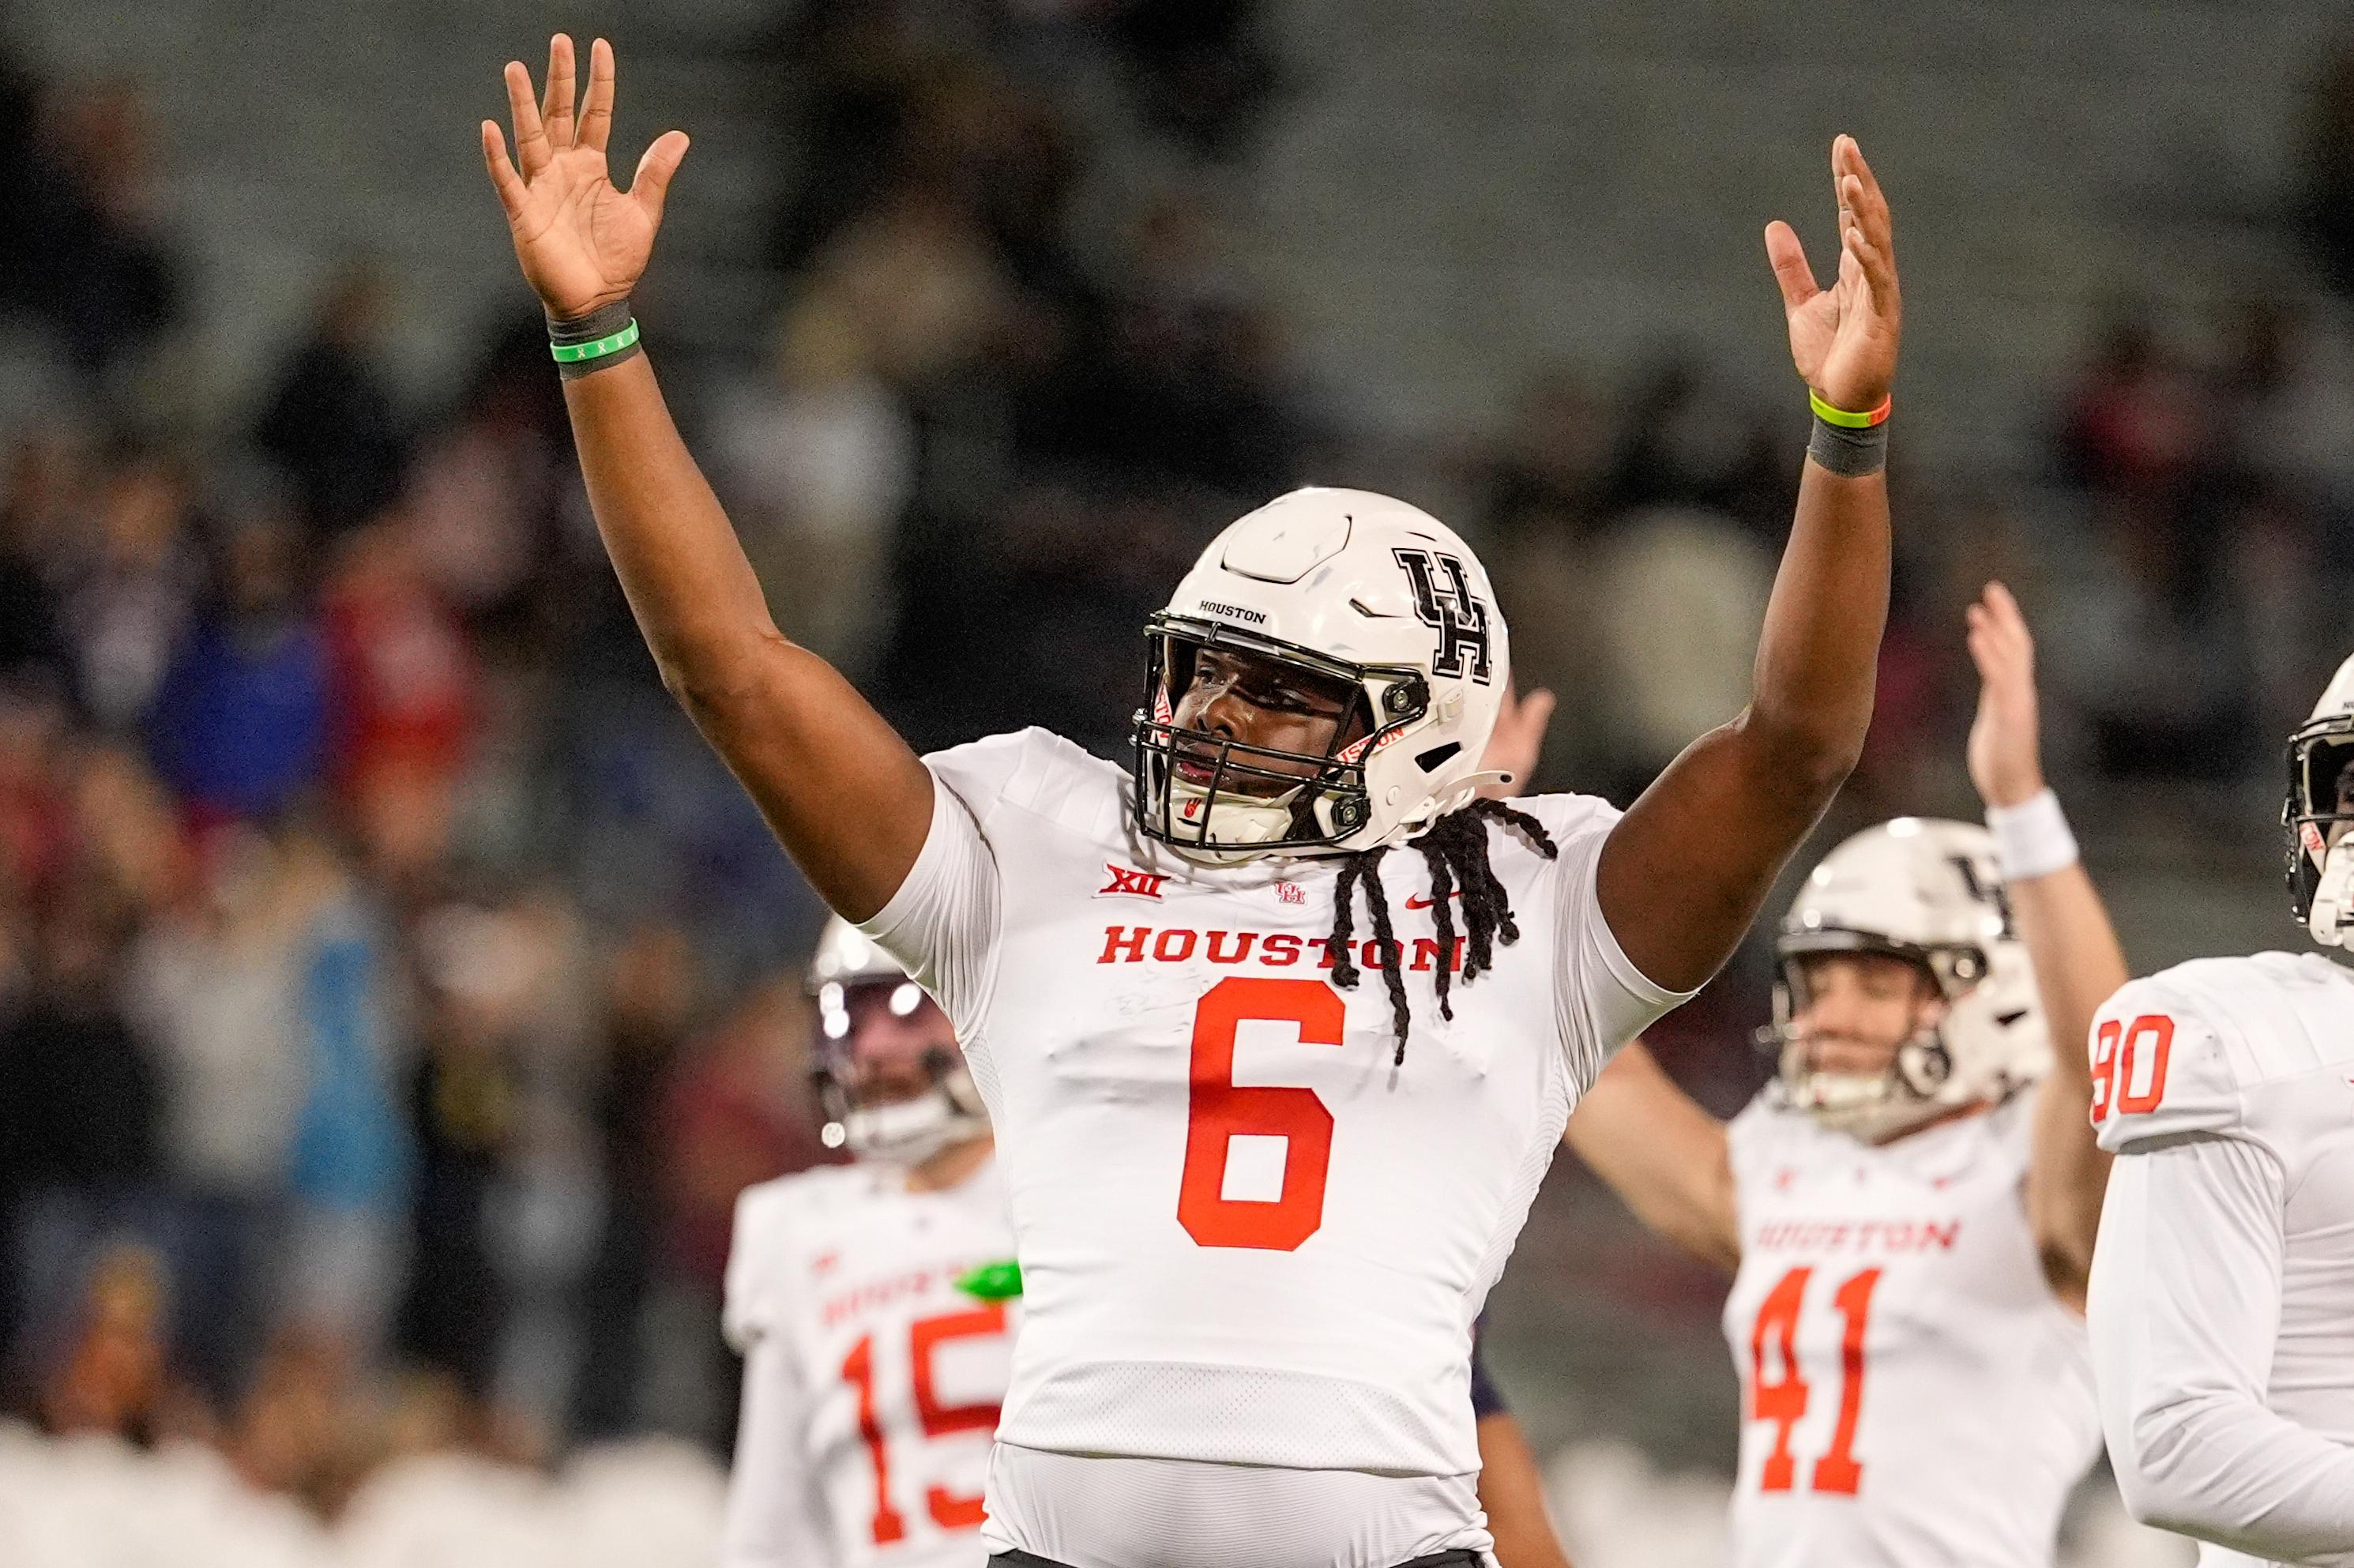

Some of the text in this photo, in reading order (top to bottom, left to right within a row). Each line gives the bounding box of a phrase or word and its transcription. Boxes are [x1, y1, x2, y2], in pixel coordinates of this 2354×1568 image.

[1199, 600, 1267, 624] HOUSTON
[1096, 925, 1466, 972] HOUSTON
[1099, 863, 1171, 898] XII
[1177, 976, 1346, 1251] 6
[840, 1303, 1006, 1544] 15
[1751, 1266, 1884, 1495] 41
